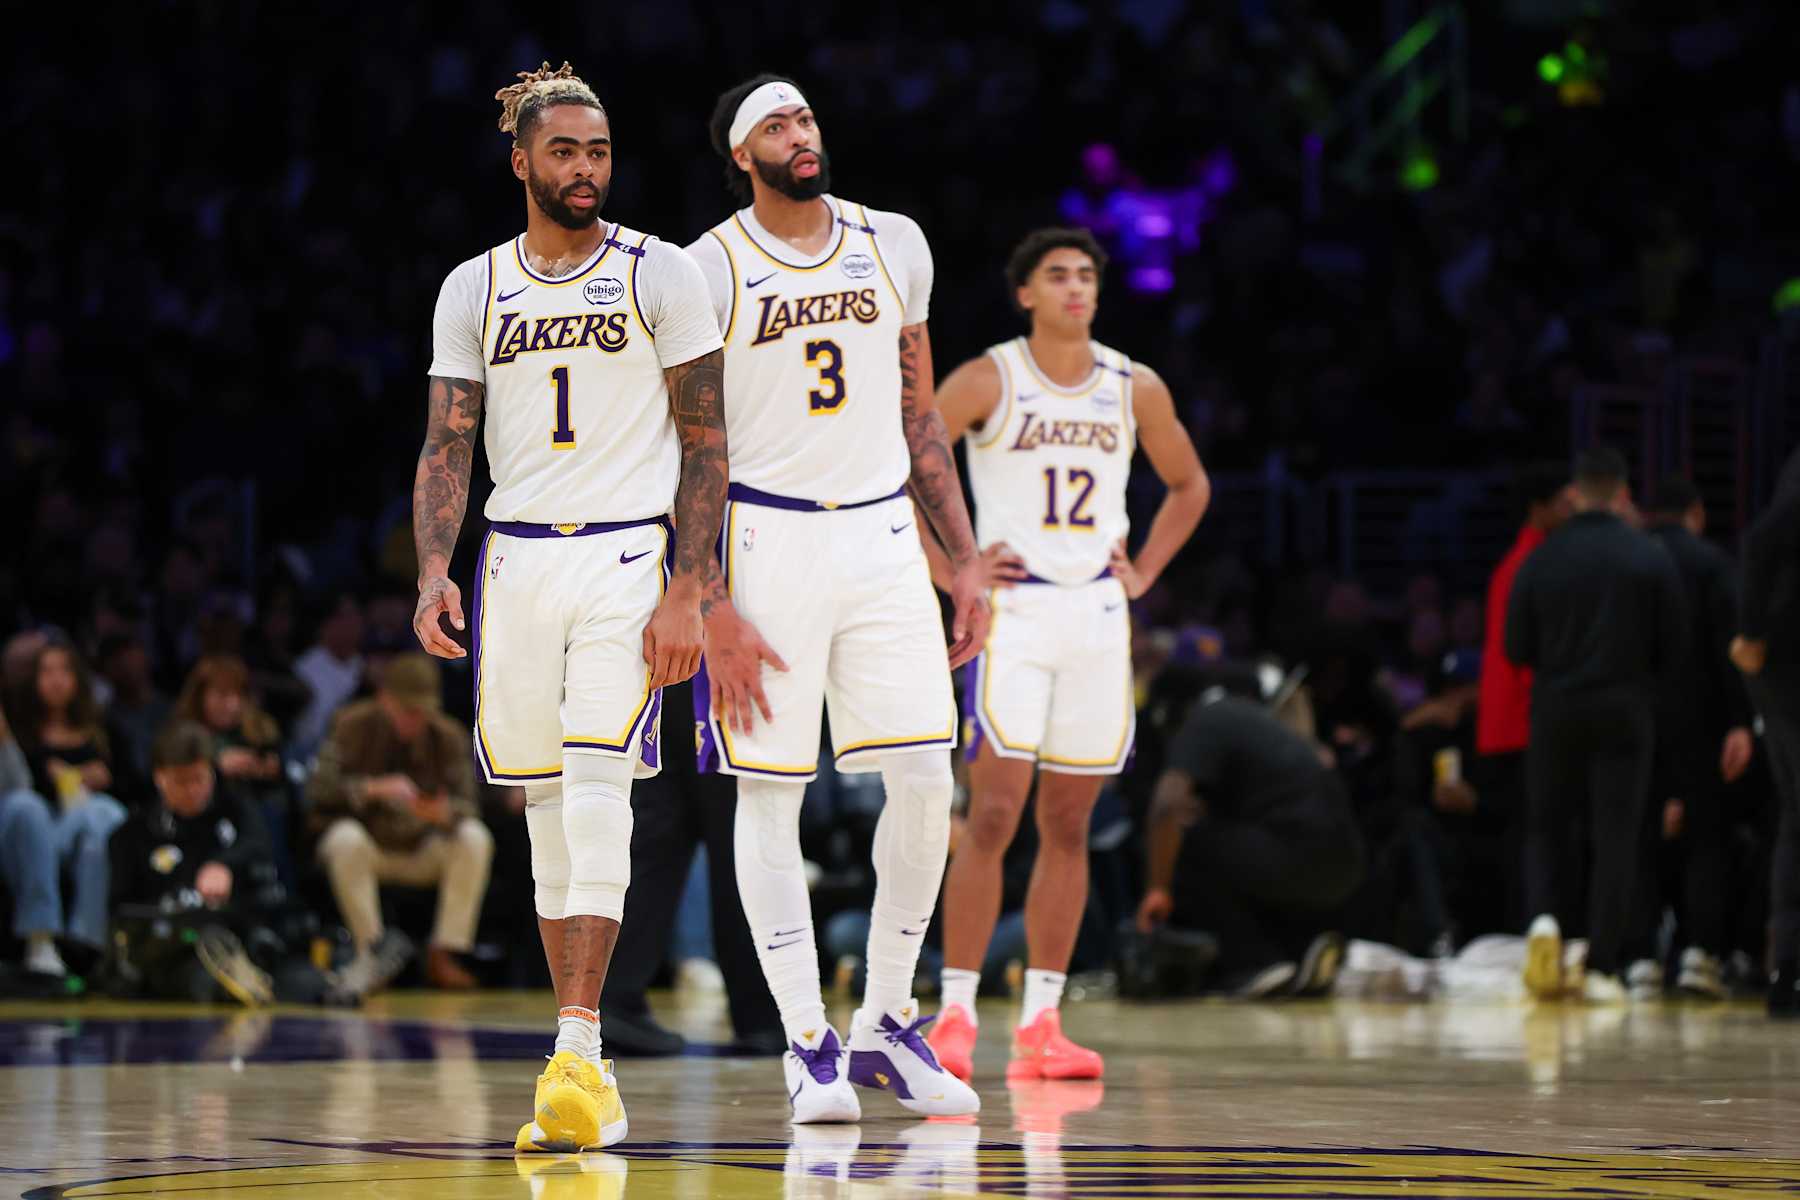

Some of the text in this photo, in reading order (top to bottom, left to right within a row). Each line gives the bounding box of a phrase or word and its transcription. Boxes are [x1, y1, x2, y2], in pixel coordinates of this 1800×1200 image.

[587, 284, 622, 297] bibigo
[750, 288, 880, 347] LAKERS
[489, 311, 630, 367] LAKERS
[803, 337, 848, 416] 3
[550, 364, 577, 450] 1
[1008, 412, 1120, 453] LAKERS
[1042, 465, 1097, 533] 12
